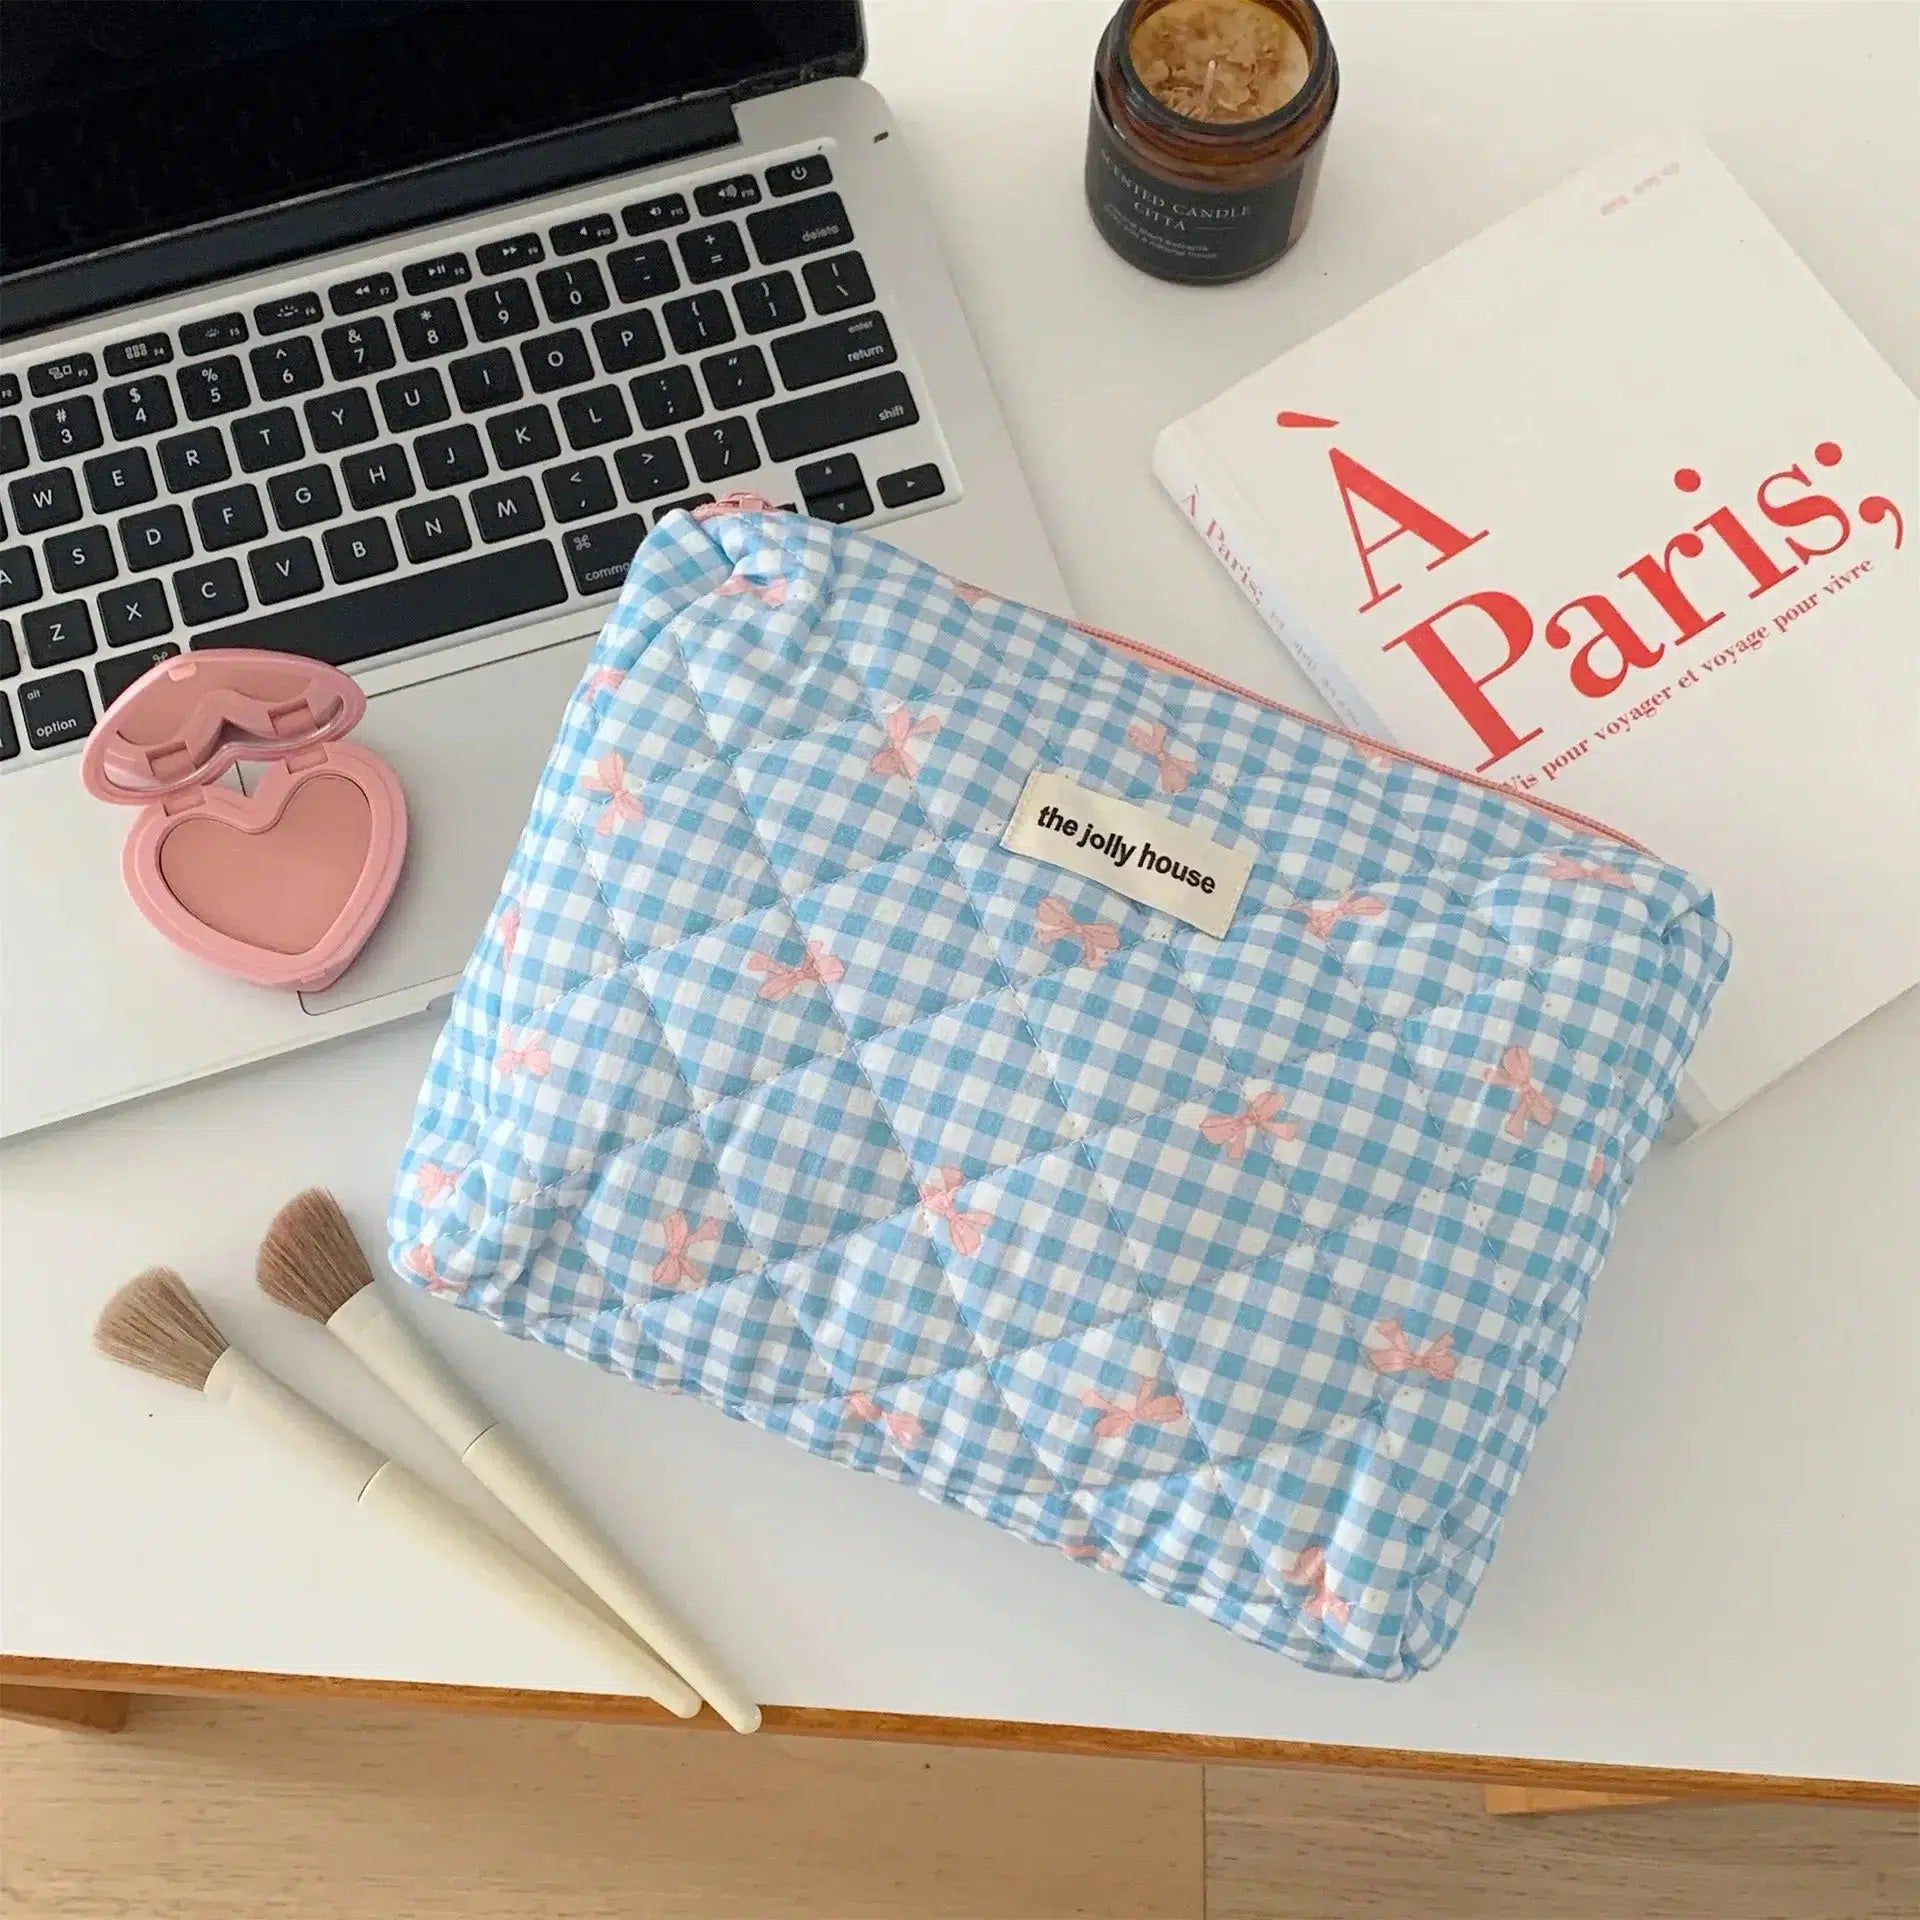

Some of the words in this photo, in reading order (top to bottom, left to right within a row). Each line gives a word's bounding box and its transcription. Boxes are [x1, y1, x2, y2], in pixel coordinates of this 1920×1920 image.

[704, 234, 715, 245] +
[802, 224, 840, 242] delete
[710, 254, 723, 264] =
[379, 286, 390, 296] F7
[569, 290, 582, 305] 0
[836, 284, 849, 296] \
[498, 309, 510, 325] 9
[848, 319, 874, 334] enter
[348, 329, 362, 344] &
[427, 329, 439, 344] 8
[620, 330, 634, 348] P
[153, 347, 165, 356] F4
[353, 347, 364, 364] 7
[547, 350, 564, 367] O
[848, 344, 885, 363] return
[201, 367, 219, 383] %
[282, 368, 294, 384] 6
[129, 387, 141, 404] $
[210, 387, 221, 403] 5
[404, 389, 421, 407] U
[56, 408, 67, 423] #
[135, 407, 147, 422] 4
[331, 408, 344, 425] Y
[588, 408, 602, 423] L
[878, 405, 904, 421] shift
[60, 428, 73, 444] 3
[259, 428, 270, 446] T
[515, 426, 532, 444] K
[713, 429, 724, 444] ?
[185, 449, 200, 467] R
[446, 447, 455, 464] J
[641, 453, 654, 465] >
[111, 469, 125, 487] E
[369, 465, 386, 484] H
[570, 471, 582, 482] <
[32, 489, 52, 508] W
[295, 487, 312, 504] G
[222, 507, 234, 525] F
[497, 498, 518, 518] M
[1277, 411, 1489, 613] À
[424, 517, 443, 537] N
[145, 528, 161, 546] D
[72, 548, 86, 565] S
[351, 541, 367, 558] B
[275, 559, 290, 577] V
[583, 560, 632, 582] comma
[0, 569, 13, 585] A
[201, 581, 217, 598] C
[125, 602, 142, 621] X
[1382, 441, 1903, 773] Paris;
[49, 623, 65, 642] Z
[1541, 738, 1590, 781] pour
[1594, 685, 1672, 742] voyager
[1677, 669, 1699, 690] et
[1701, 625, 1770, 672] voyage
[1772, 592, 1819, 634] pour
[1823, 559, 1873, 596] vivre
[27, 689, 41, 700] alt
[36, 718, 78, 738] option
[1037, 805, 1079, 837] the
[1076, 823, 1137, 868] jolly
[1137, 842, 1216, 895] house
